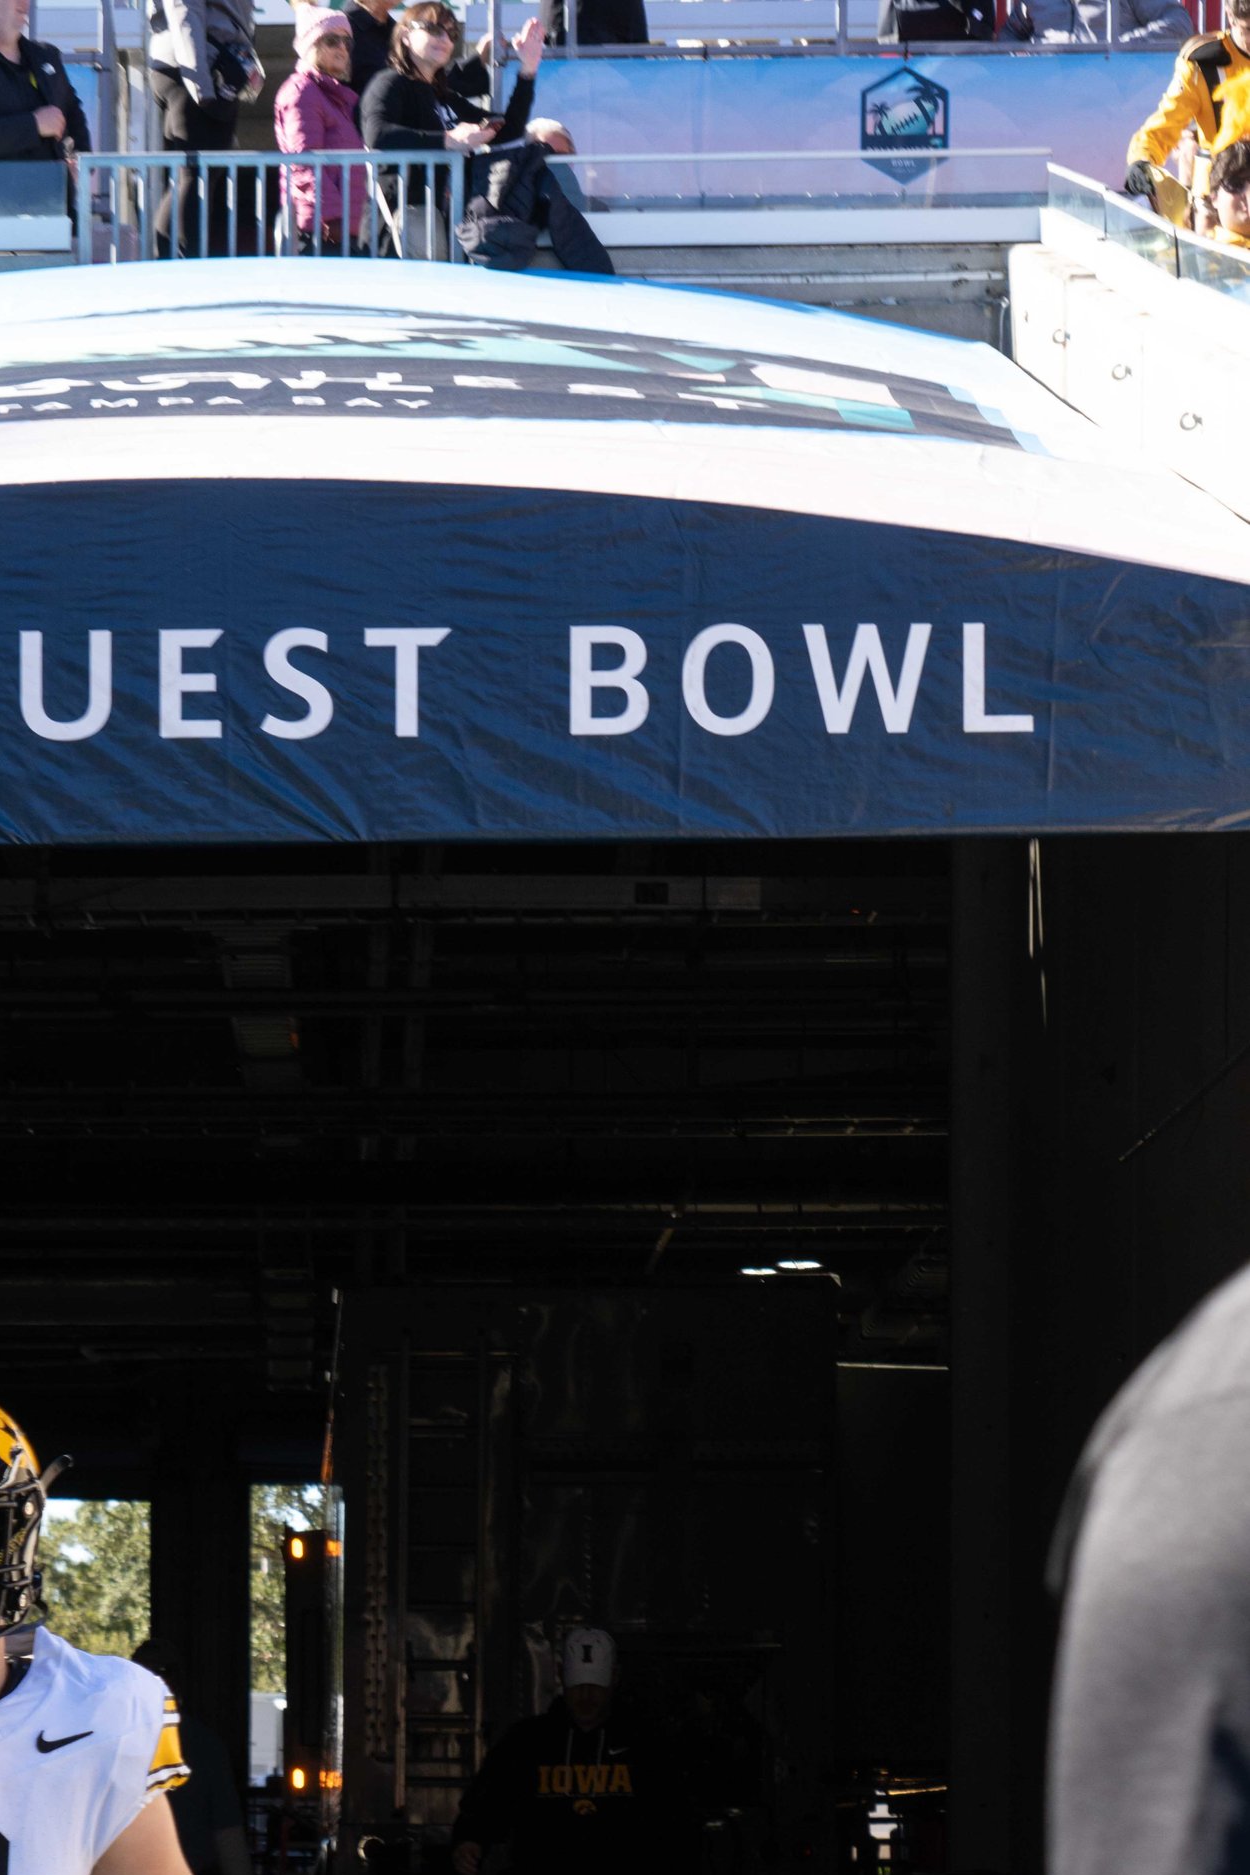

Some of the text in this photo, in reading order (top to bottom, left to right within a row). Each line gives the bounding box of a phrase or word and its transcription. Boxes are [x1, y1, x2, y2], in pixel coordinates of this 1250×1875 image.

[292, 395, 432, 410] BAY
[569, 622, 1034, 737] BOWL
[581, 1645, 593, 1663] I
[537, 1763, 633, 1794] IOWA
